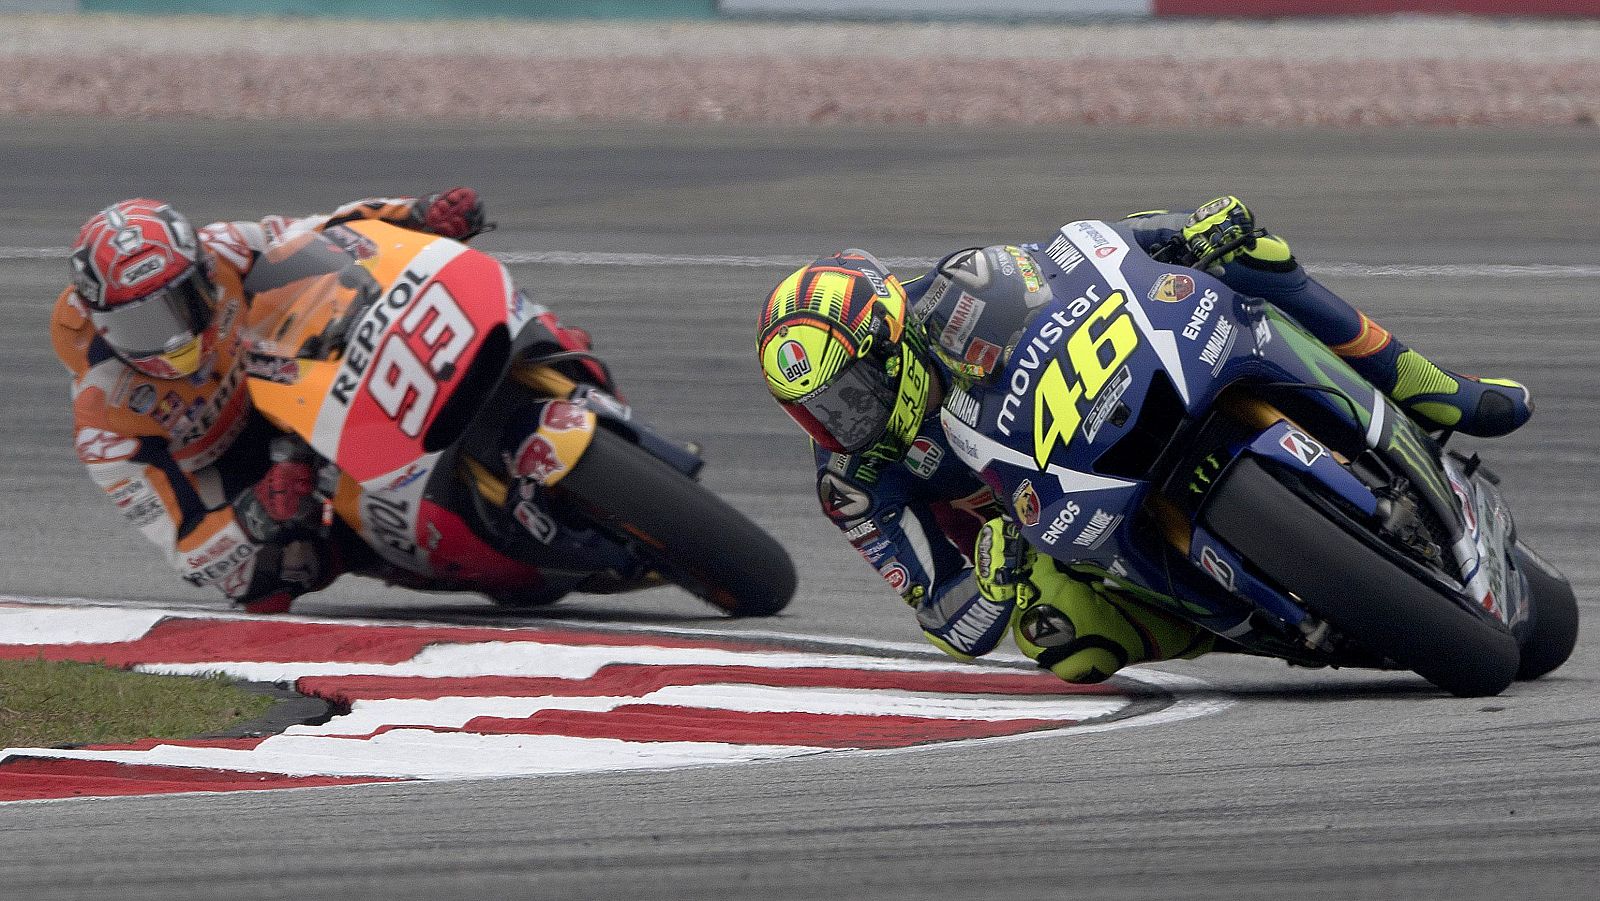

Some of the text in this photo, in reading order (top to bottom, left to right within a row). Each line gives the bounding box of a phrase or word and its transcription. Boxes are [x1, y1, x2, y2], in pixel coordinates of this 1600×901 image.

[1045, 234, 1085, 275] YAMAHA
[918, 280, 949, 321] DGESTONE
[1182, 288, 1218, 341] ENEOS
[330, 269, 429, 406] REPSOL
[367, 280, 477, 438] 93
[997, 284, 1100, 436] movistar
[1199, 315, 1233, 366] YAMALUBE
[947, 386, 981, 428] YAMAHA
[1034, 291, 1138, 471] 46
[1041, 500, 1081, 545] ENEOS
[1073, 509, 1115, 547] YAMALUBE
[942, 597, 1006, 652] YAMAHA
